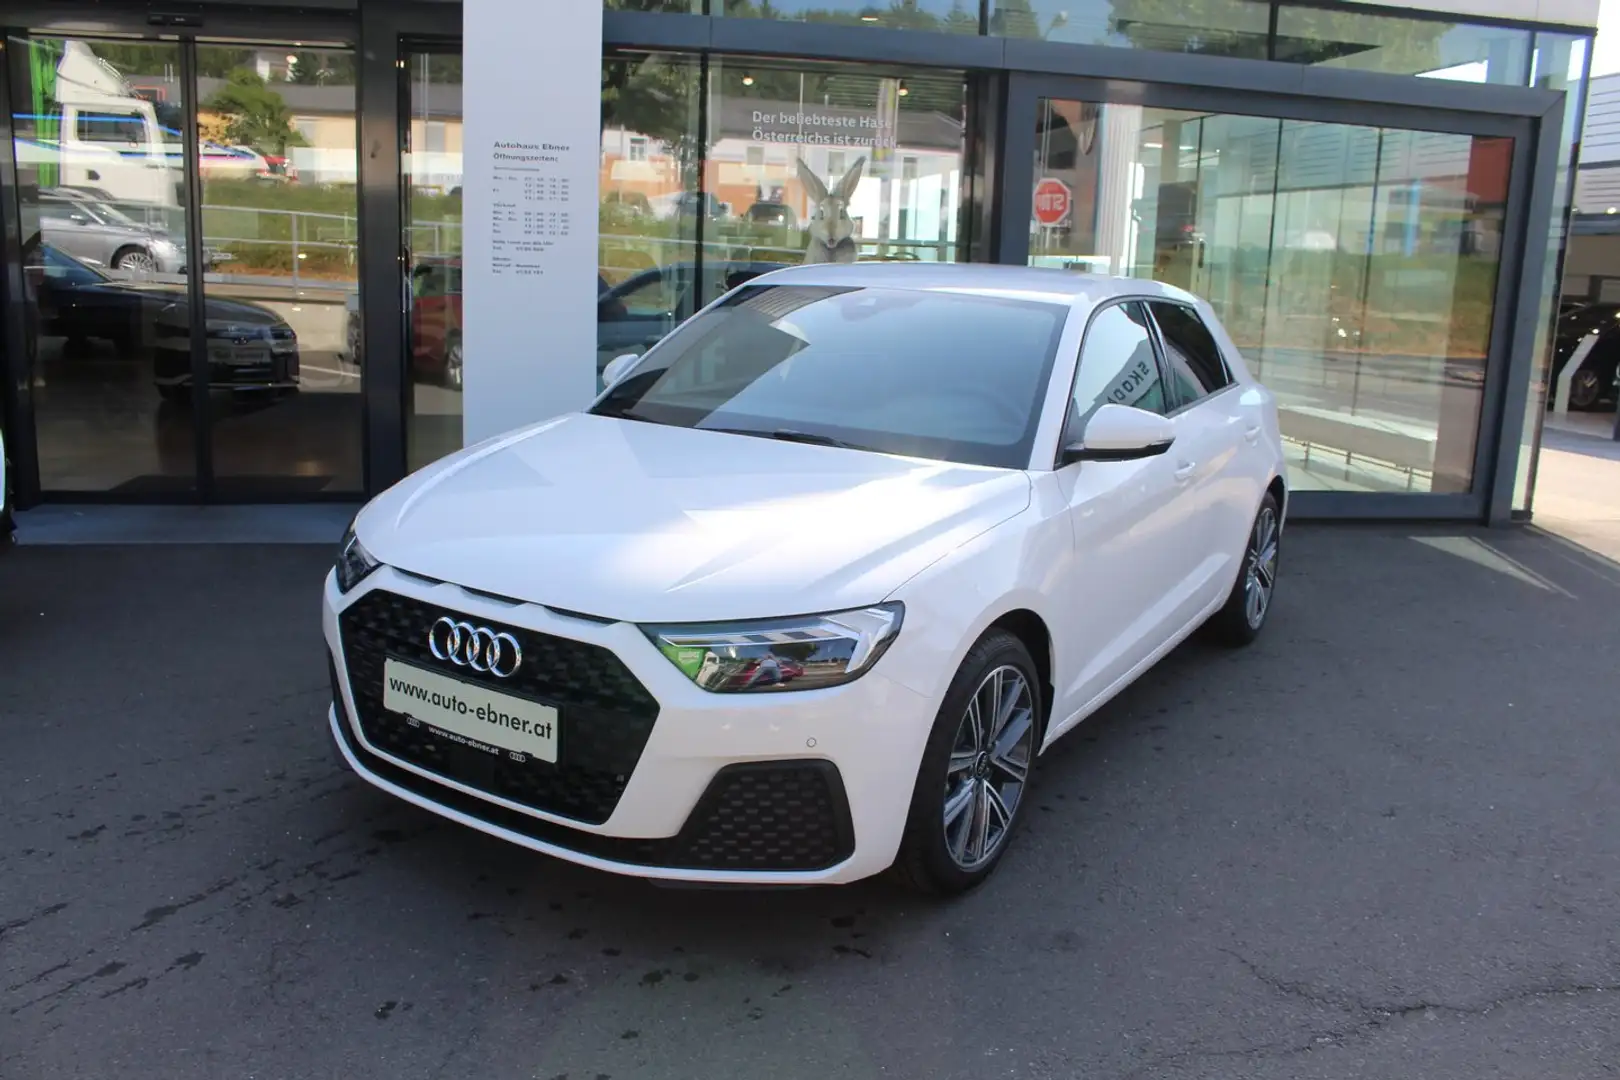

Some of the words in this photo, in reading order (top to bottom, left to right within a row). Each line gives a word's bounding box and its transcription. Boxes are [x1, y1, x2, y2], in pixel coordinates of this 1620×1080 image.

[752, 110, 776, 124] Der
[779, 111, 857, 128] beliebteste
[859, 115, 892, 129] Hase
[493, 141, 540, 150] Autohaus
[542, 143, 570, 151] Ebner
[752, 126, 831, 145] Österreichs
[833, 132, 853, 146] ist
[388, 676, 553, 740] www.auto-ebner.at
[428, 726, 500, 756] www.auto-ebner.at
